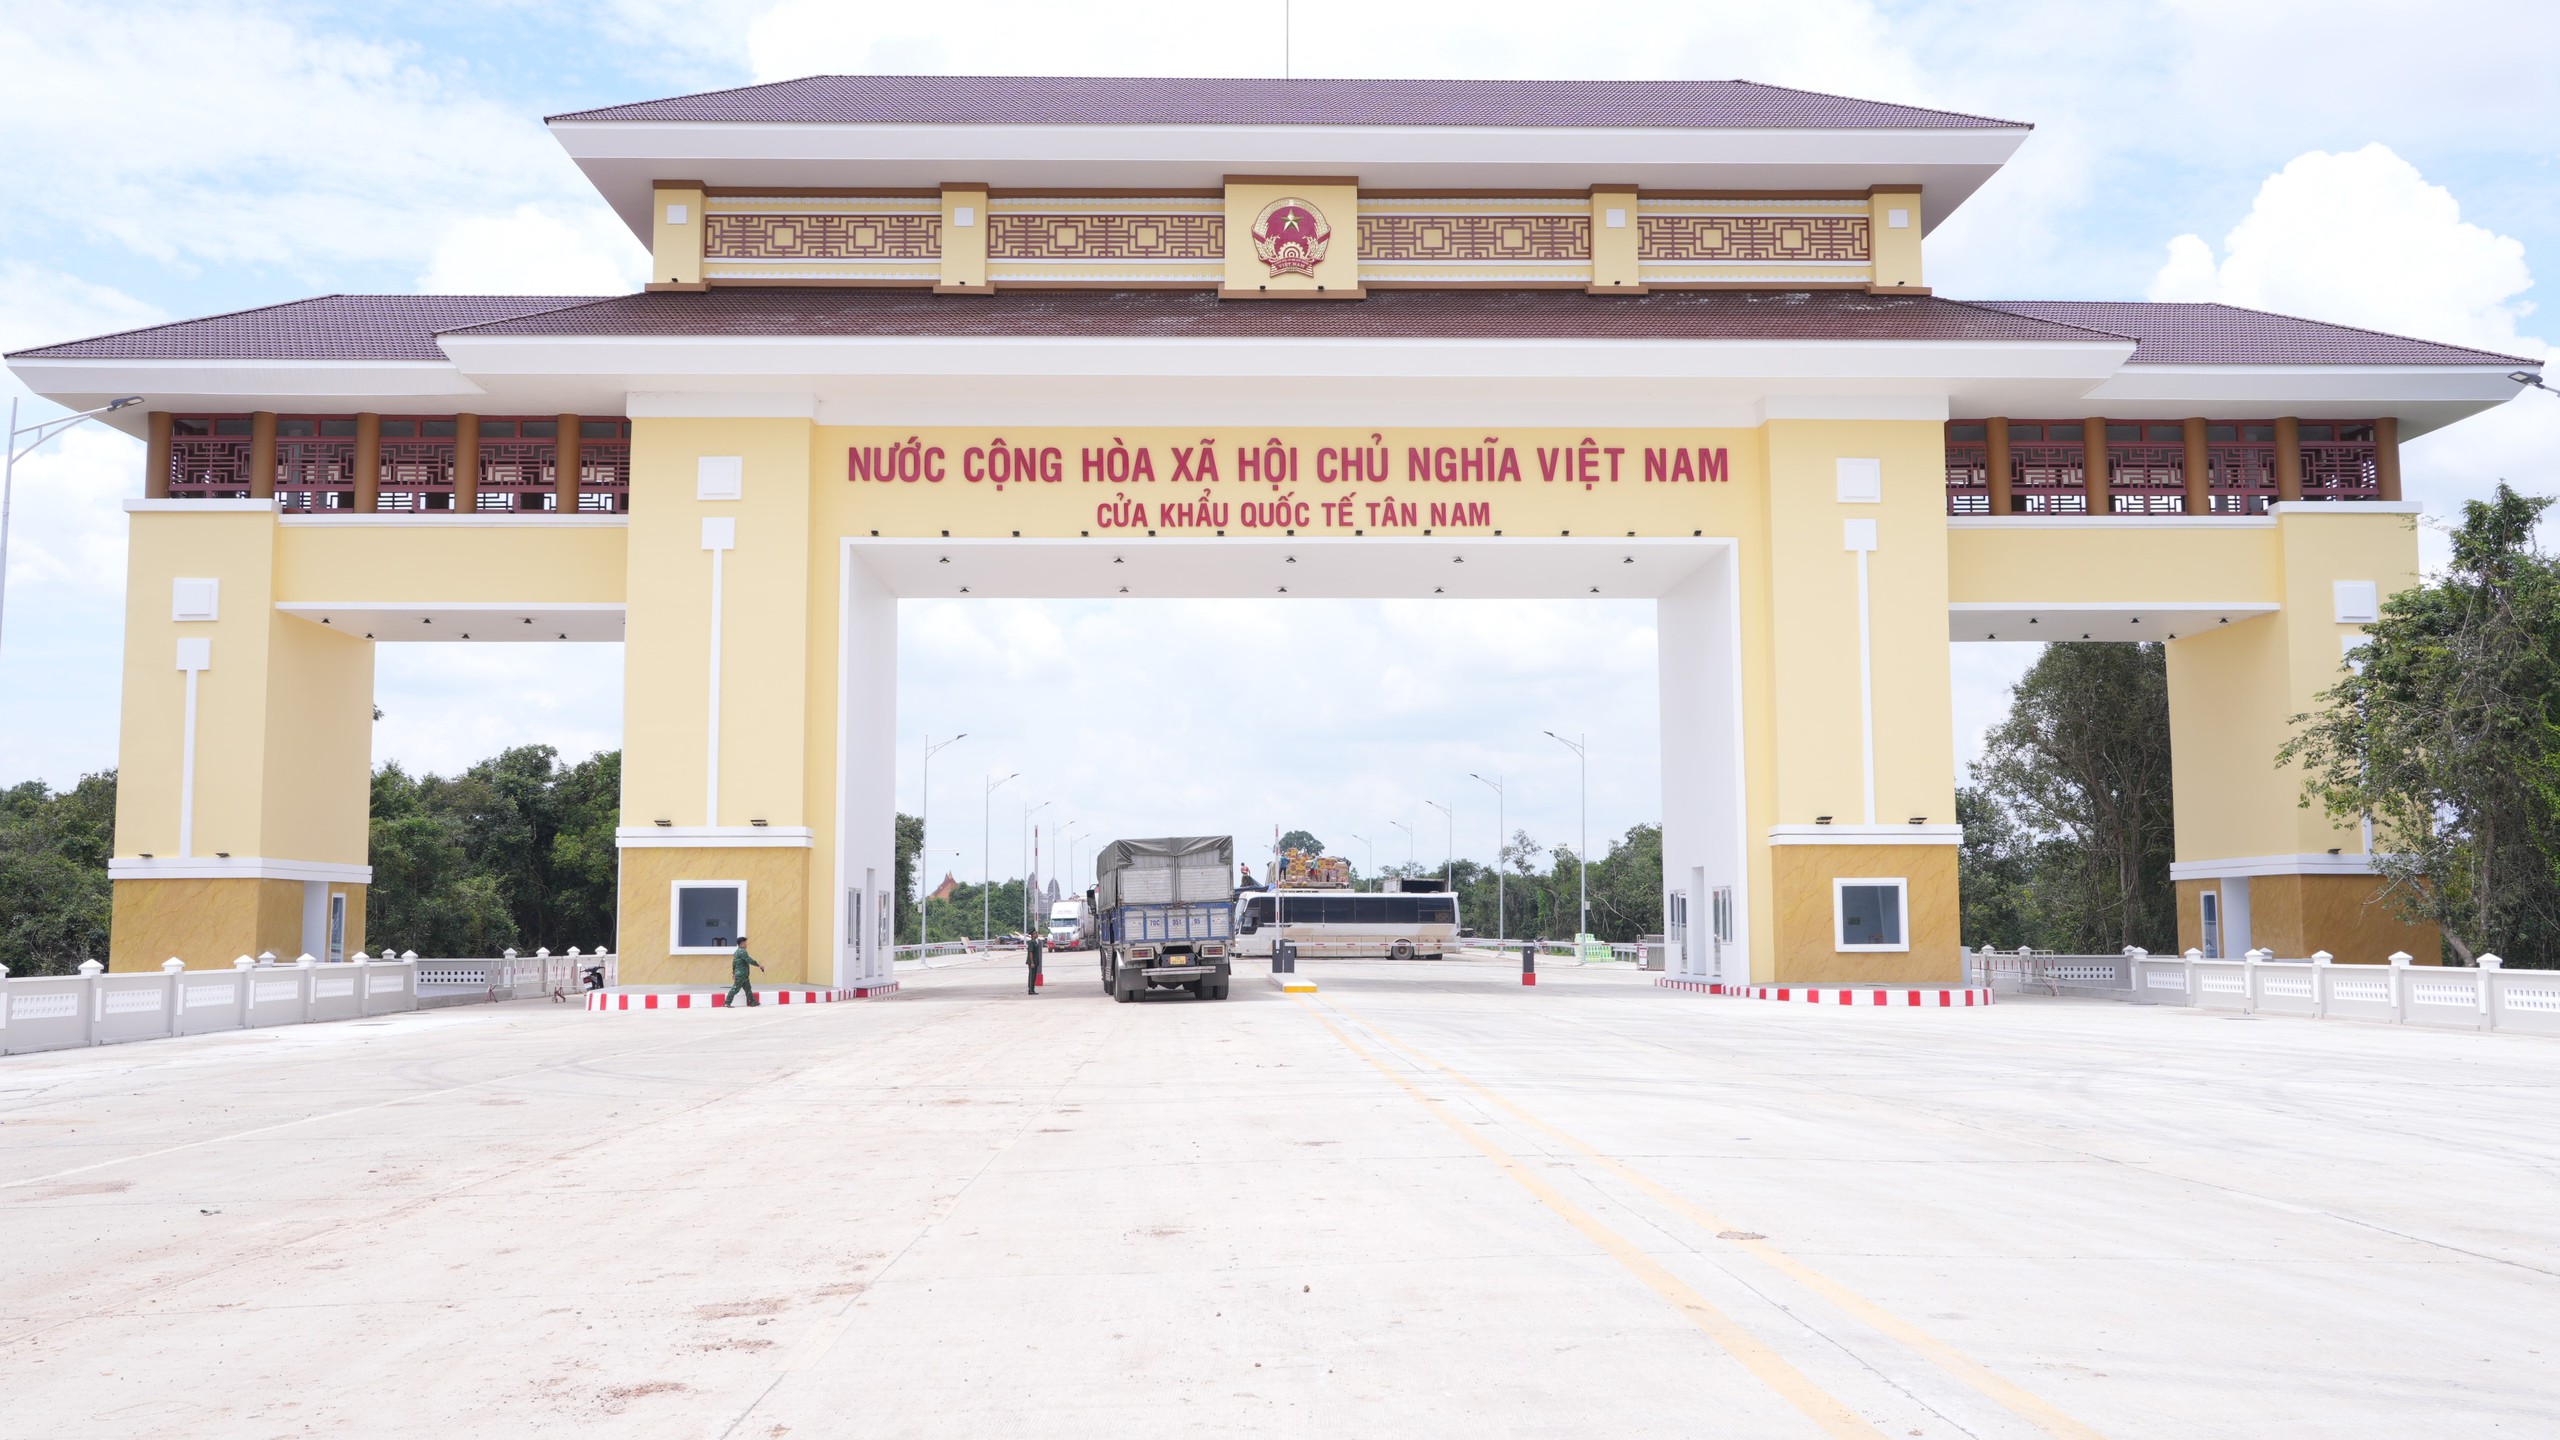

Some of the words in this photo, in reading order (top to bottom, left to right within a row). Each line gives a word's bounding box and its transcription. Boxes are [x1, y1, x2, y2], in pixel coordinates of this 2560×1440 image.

[848, 436, 945, 482] NƯỚC
[963, 437, 1062, 491] CỘNG
[1082, 437, 1155, 482] HÒA
[1171, 438, 1219, 482] XÃ
[1238, 438, 1297, 491] HỘI
[1316, 433, 1388, 482] CHỦ
[1408, 437, 1521, 482] NGHĨA
[1537, 437, 1626, 490] VIỆT
[1644, 447, 1728, 482] NAM
[1097, 492, 1148, 528] CỬA
[1160, 488, 1228, 528] KHẨU
[1240, 492, 1310, 529] QUỐC
[1321, 492, 1356, 527] TẾ
[1366, 496, 1418, 527] TÂN
[1430, 502, 1491, 527] NAM
